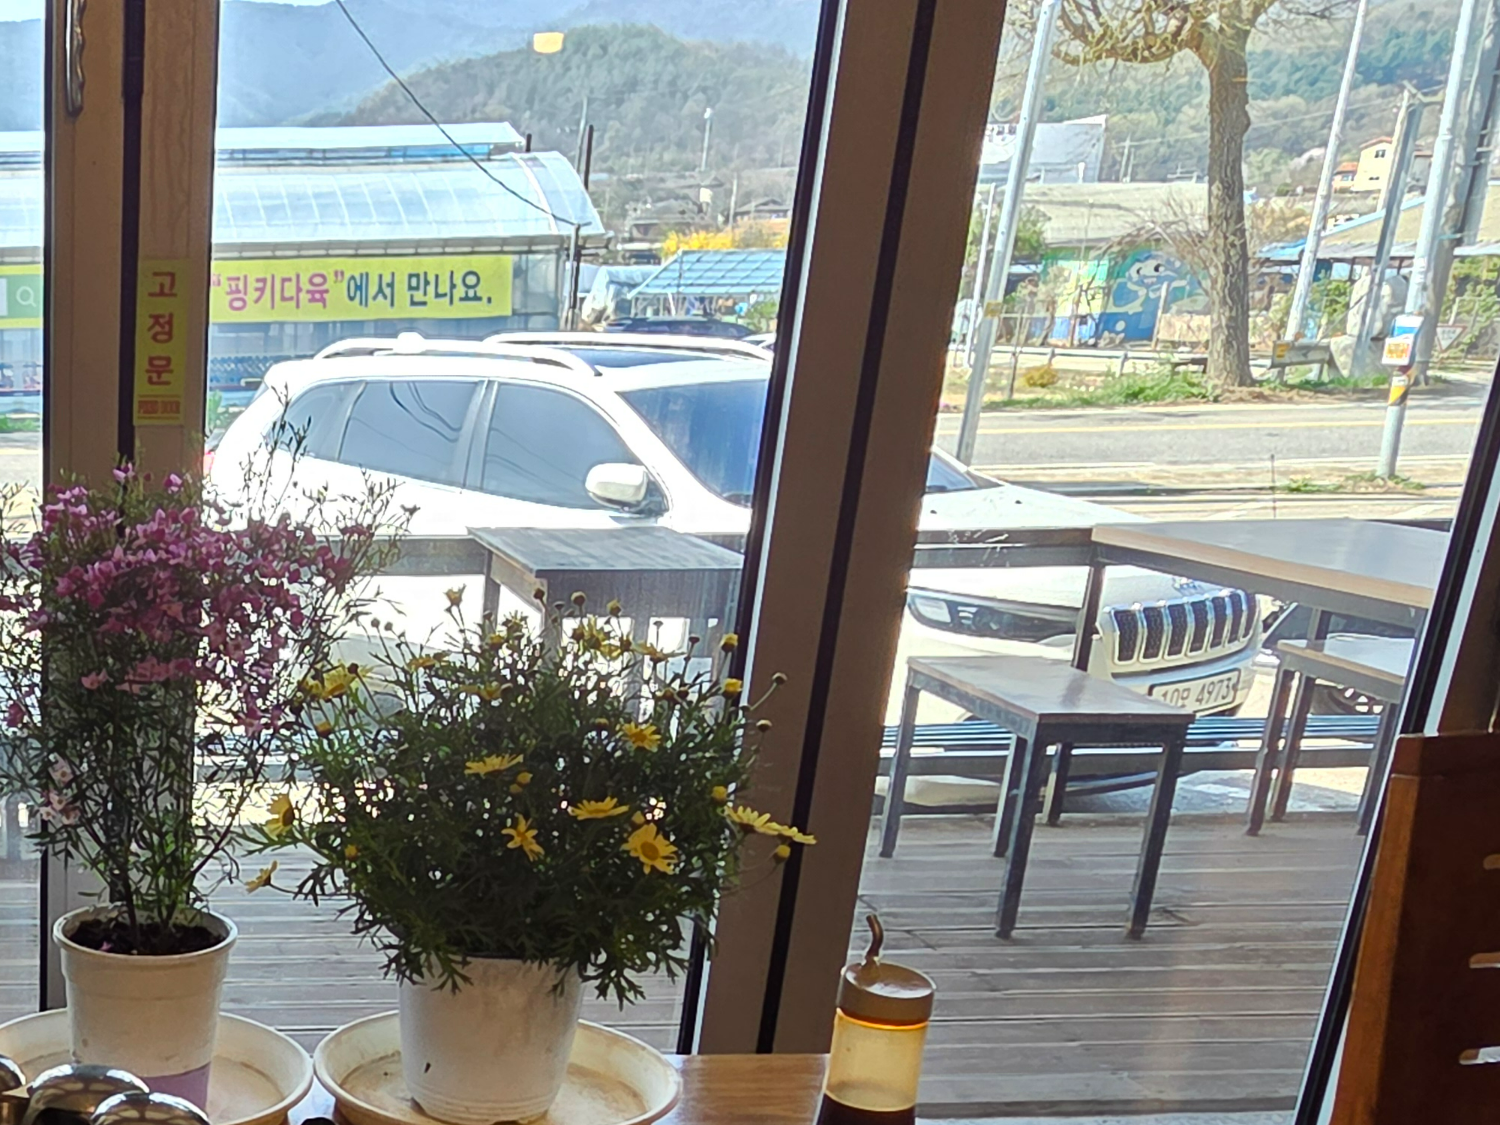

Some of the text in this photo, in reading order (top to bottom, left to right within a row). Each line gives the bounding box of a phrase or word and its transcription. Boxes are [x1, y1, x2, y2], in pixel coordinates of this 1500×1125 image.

[407, 270, 493, 308] 만나요.
[145, 271, 177, 386] 고정문
[1195, 677, 1232, 706] 4973
